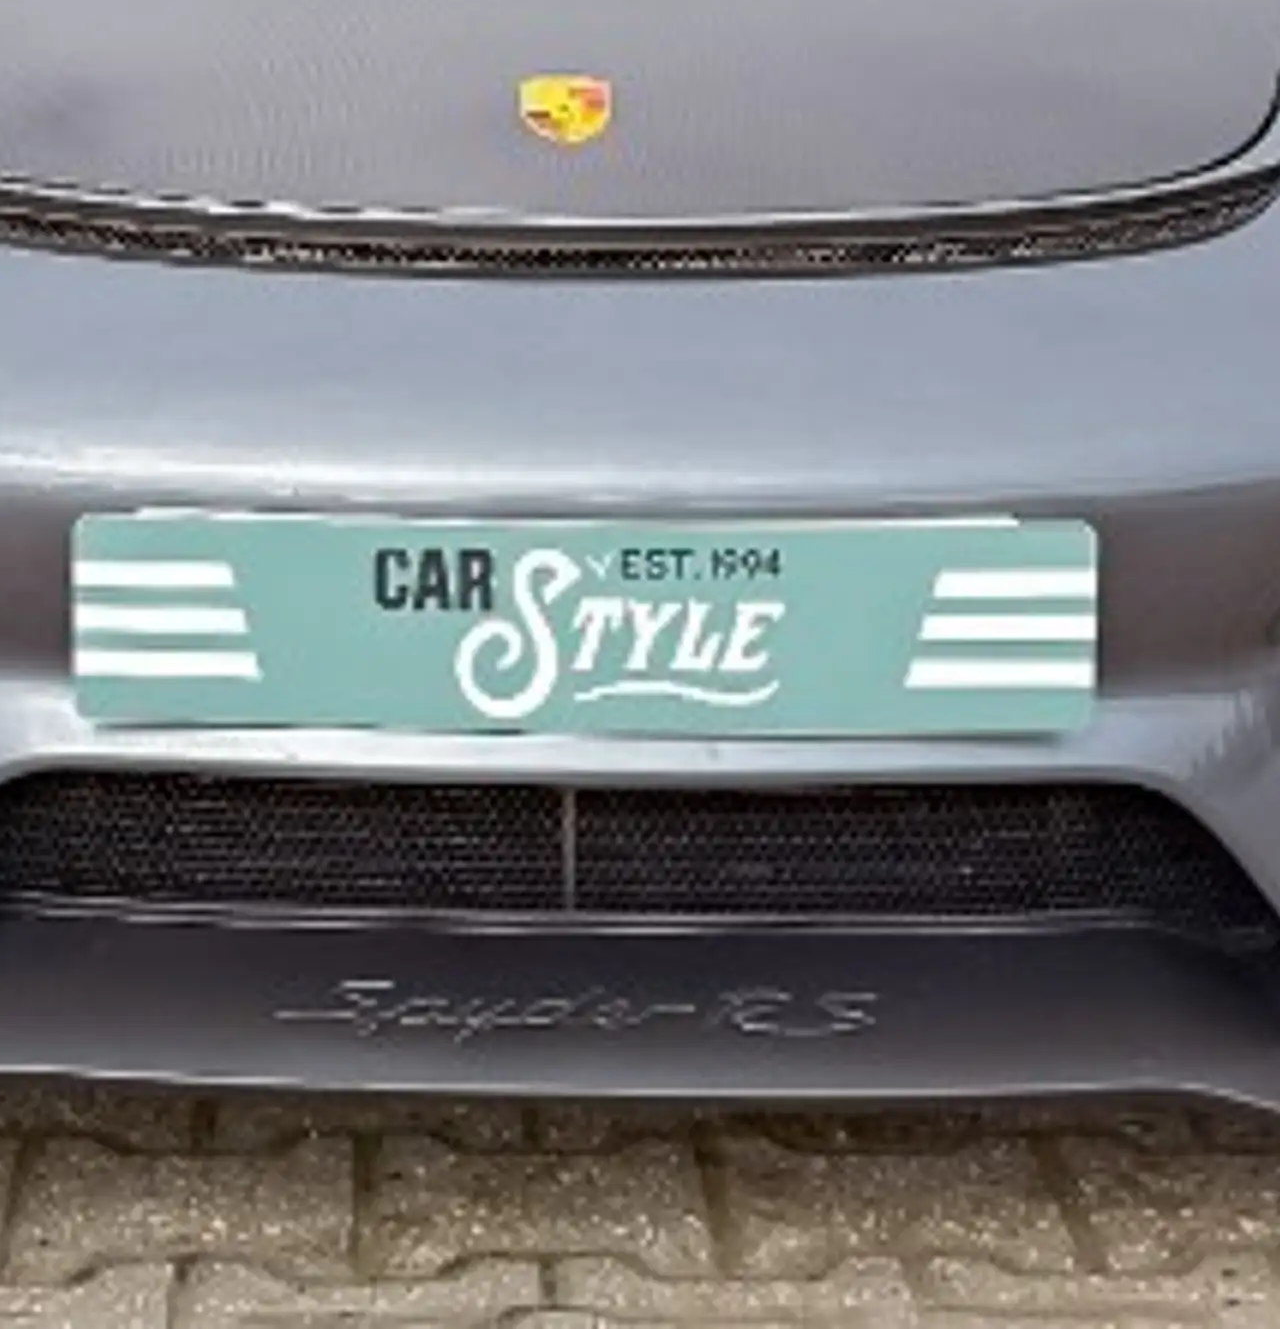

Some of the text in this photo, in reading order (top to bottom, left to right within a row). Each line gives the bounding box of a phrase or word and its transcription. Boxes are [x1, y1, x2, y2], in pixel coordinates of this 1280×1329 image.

[621, 547, 781, 582] EST. 1994
[374, 547, 786, 720] CAR STYLE
